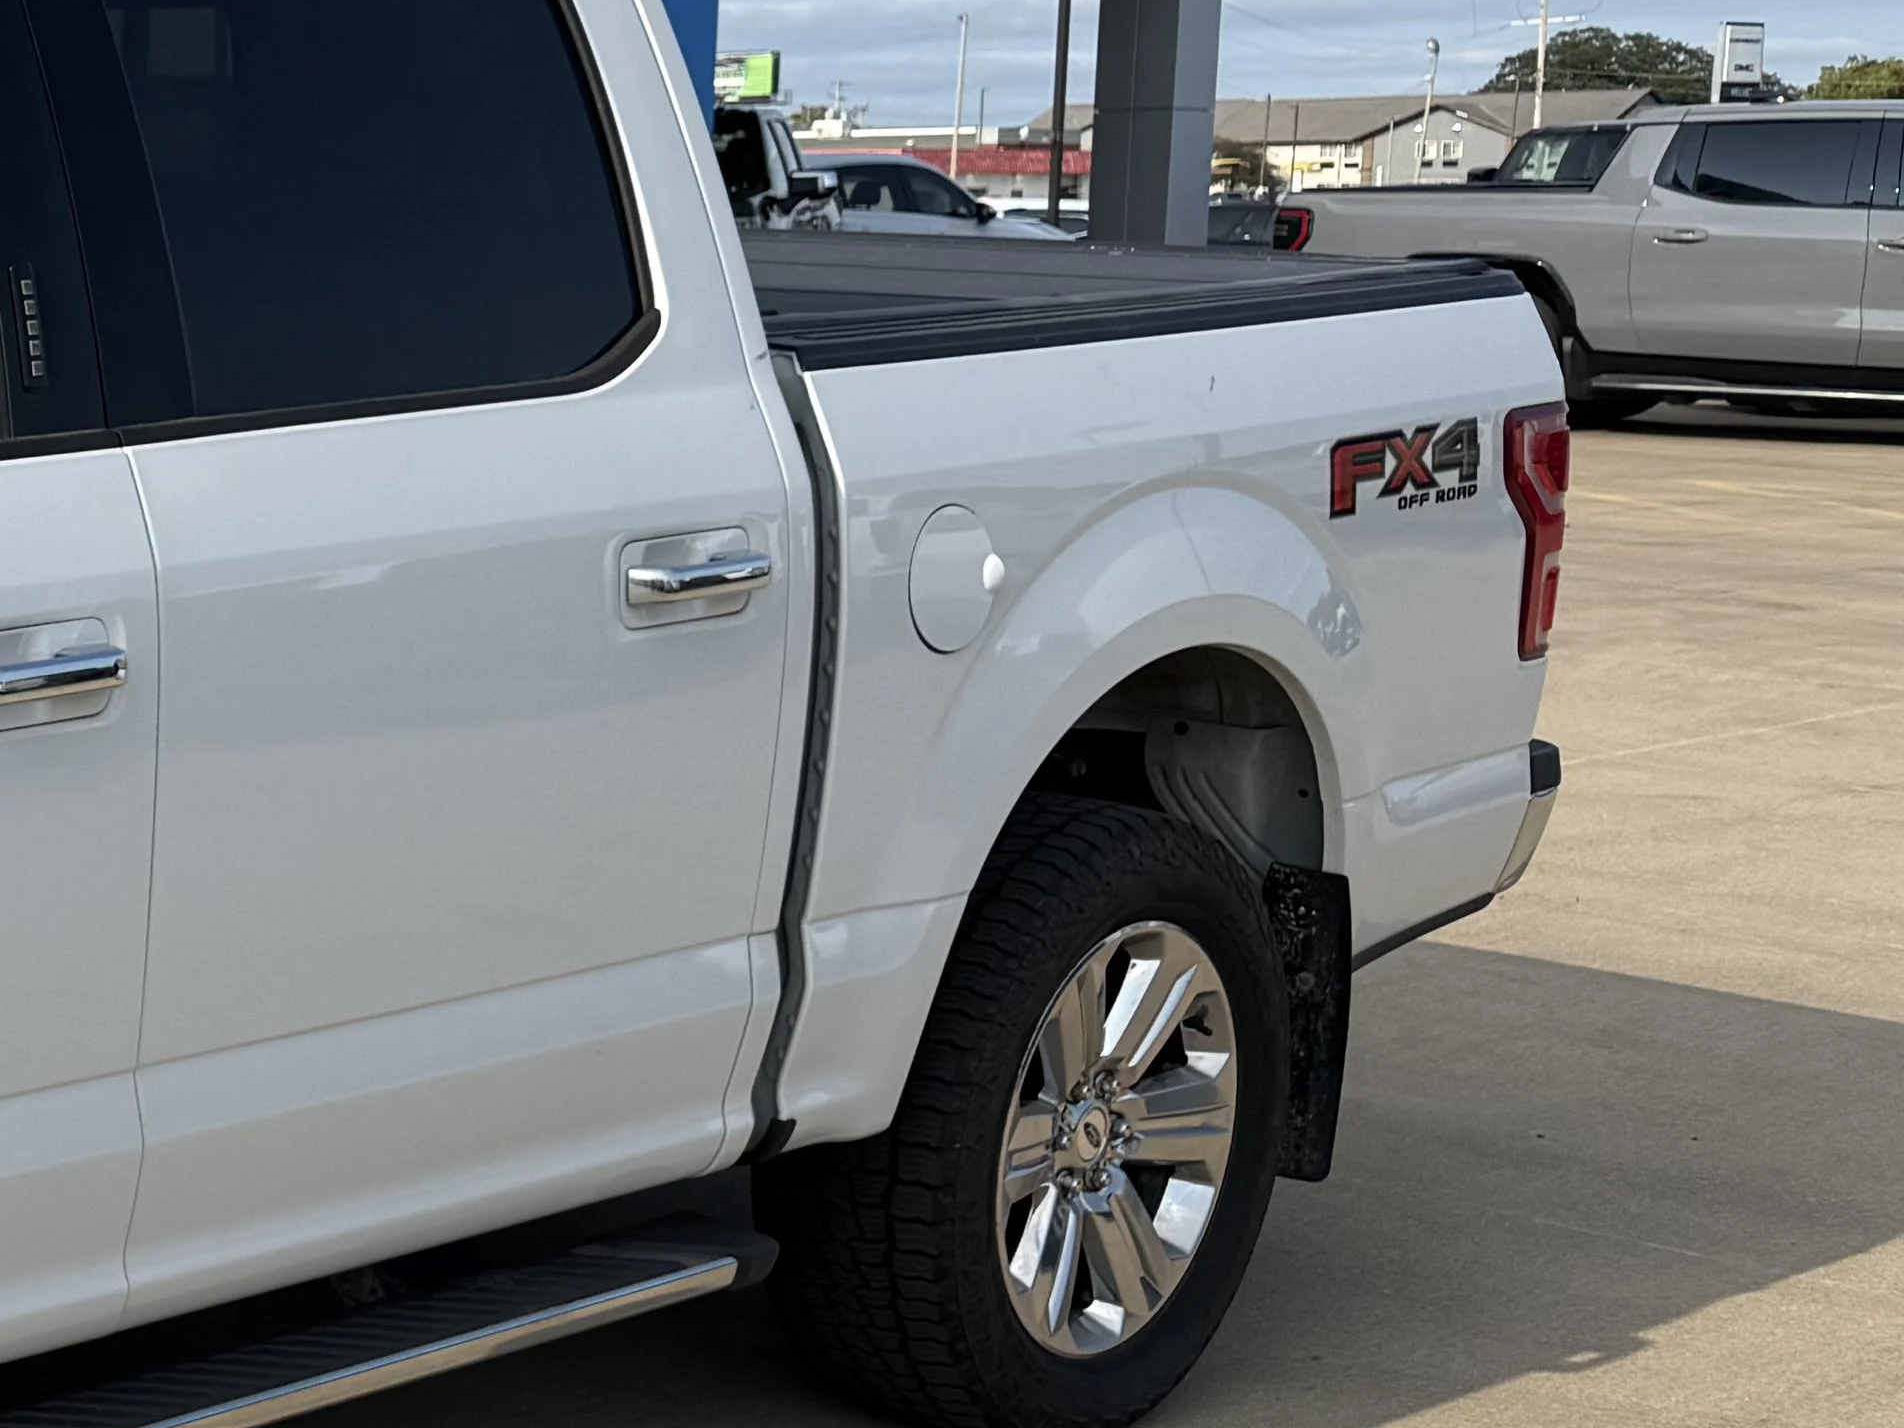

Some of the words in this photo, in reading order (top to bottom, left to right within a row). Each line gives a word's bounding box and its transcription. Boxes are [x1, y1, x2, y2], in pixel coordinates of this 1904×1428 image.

[1329, 416, 1481, 520] FX4
[1396, 494, 1430, 511] OFF
[1435, 483, 1478, 505] ROAD
